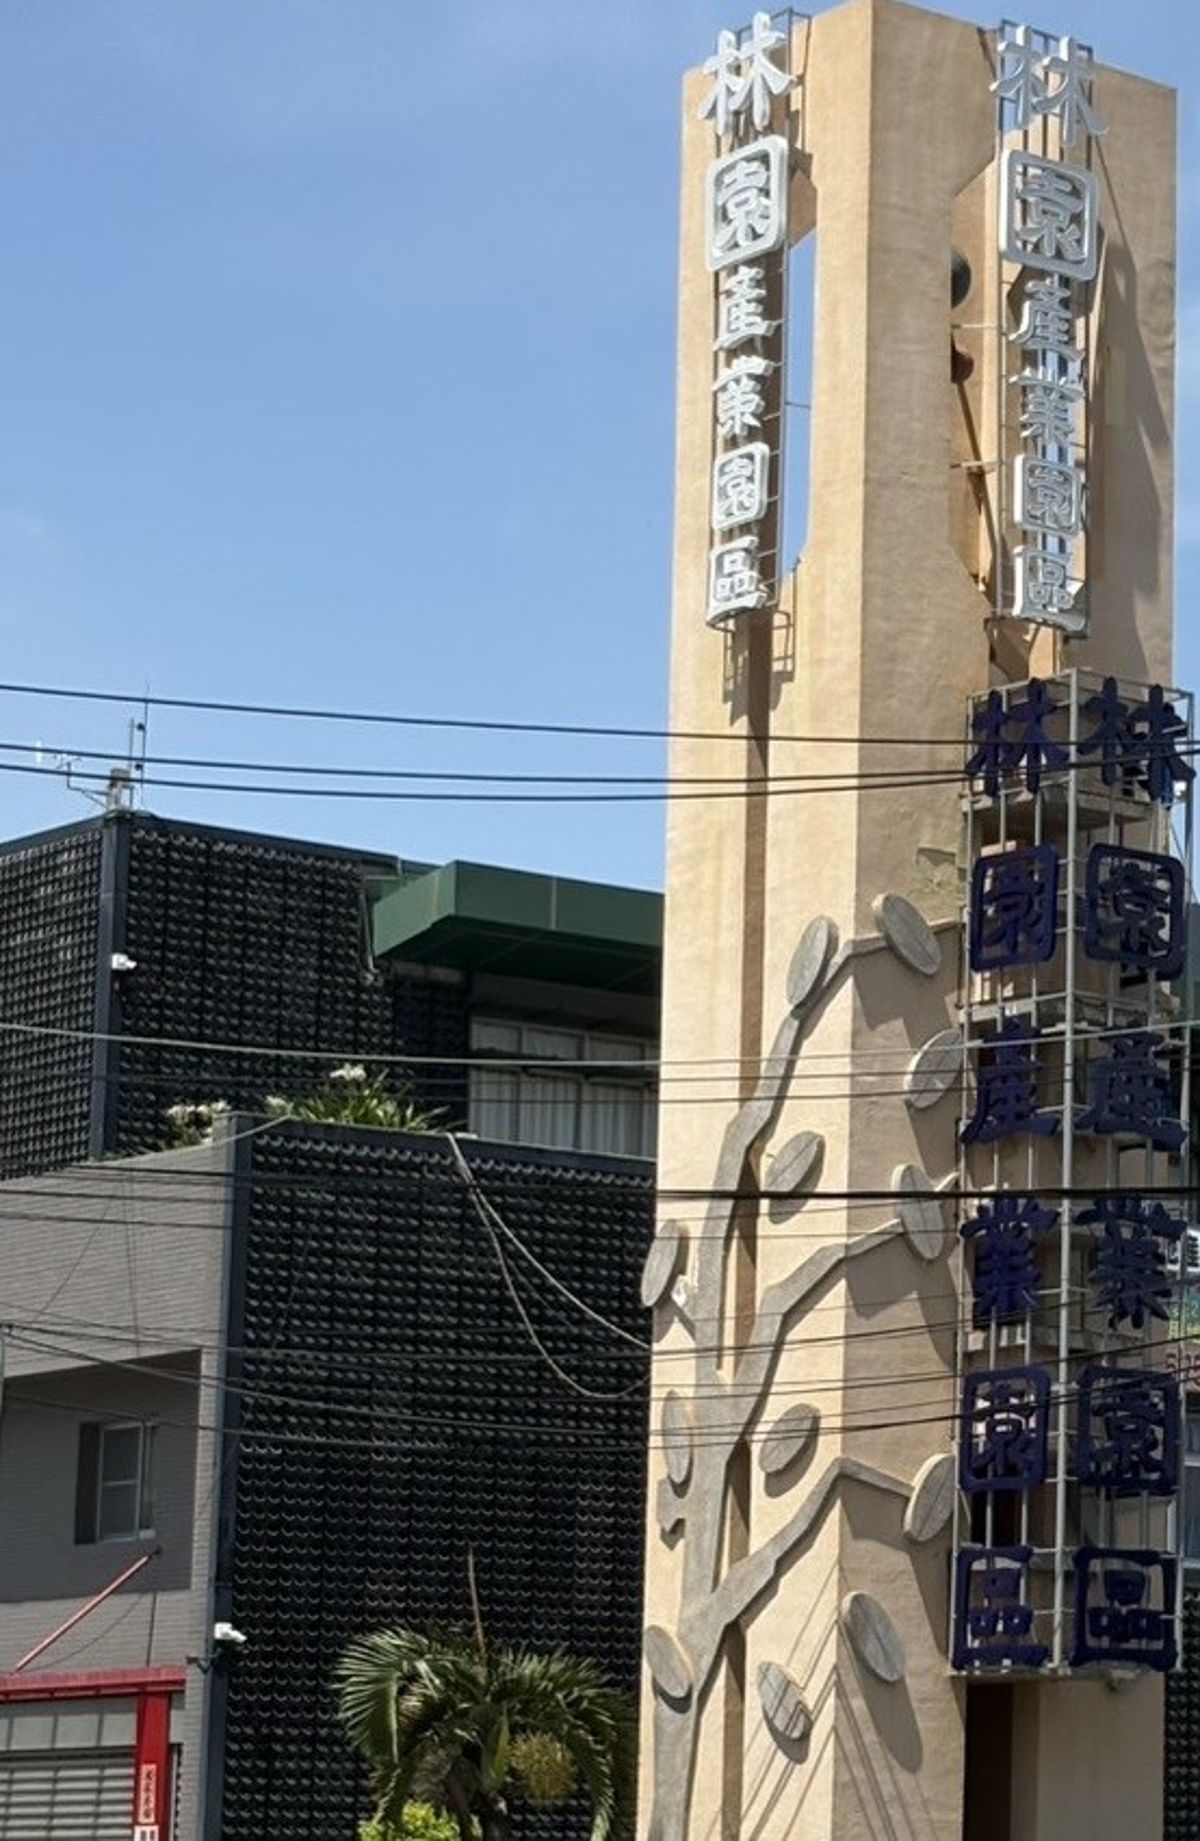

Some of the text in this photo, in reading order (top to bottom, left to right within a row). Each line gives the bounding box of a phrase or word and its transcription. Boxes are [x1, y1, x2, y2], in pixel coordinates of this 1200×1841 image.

[700, 12, 798, 630] 林園產業園區
[990, 25, 1108, 632] 林園產業園區
[952, 677, 1069, 1670] 林園產業園區
[1072, 676, 1196, 1671] 林園產業園區
